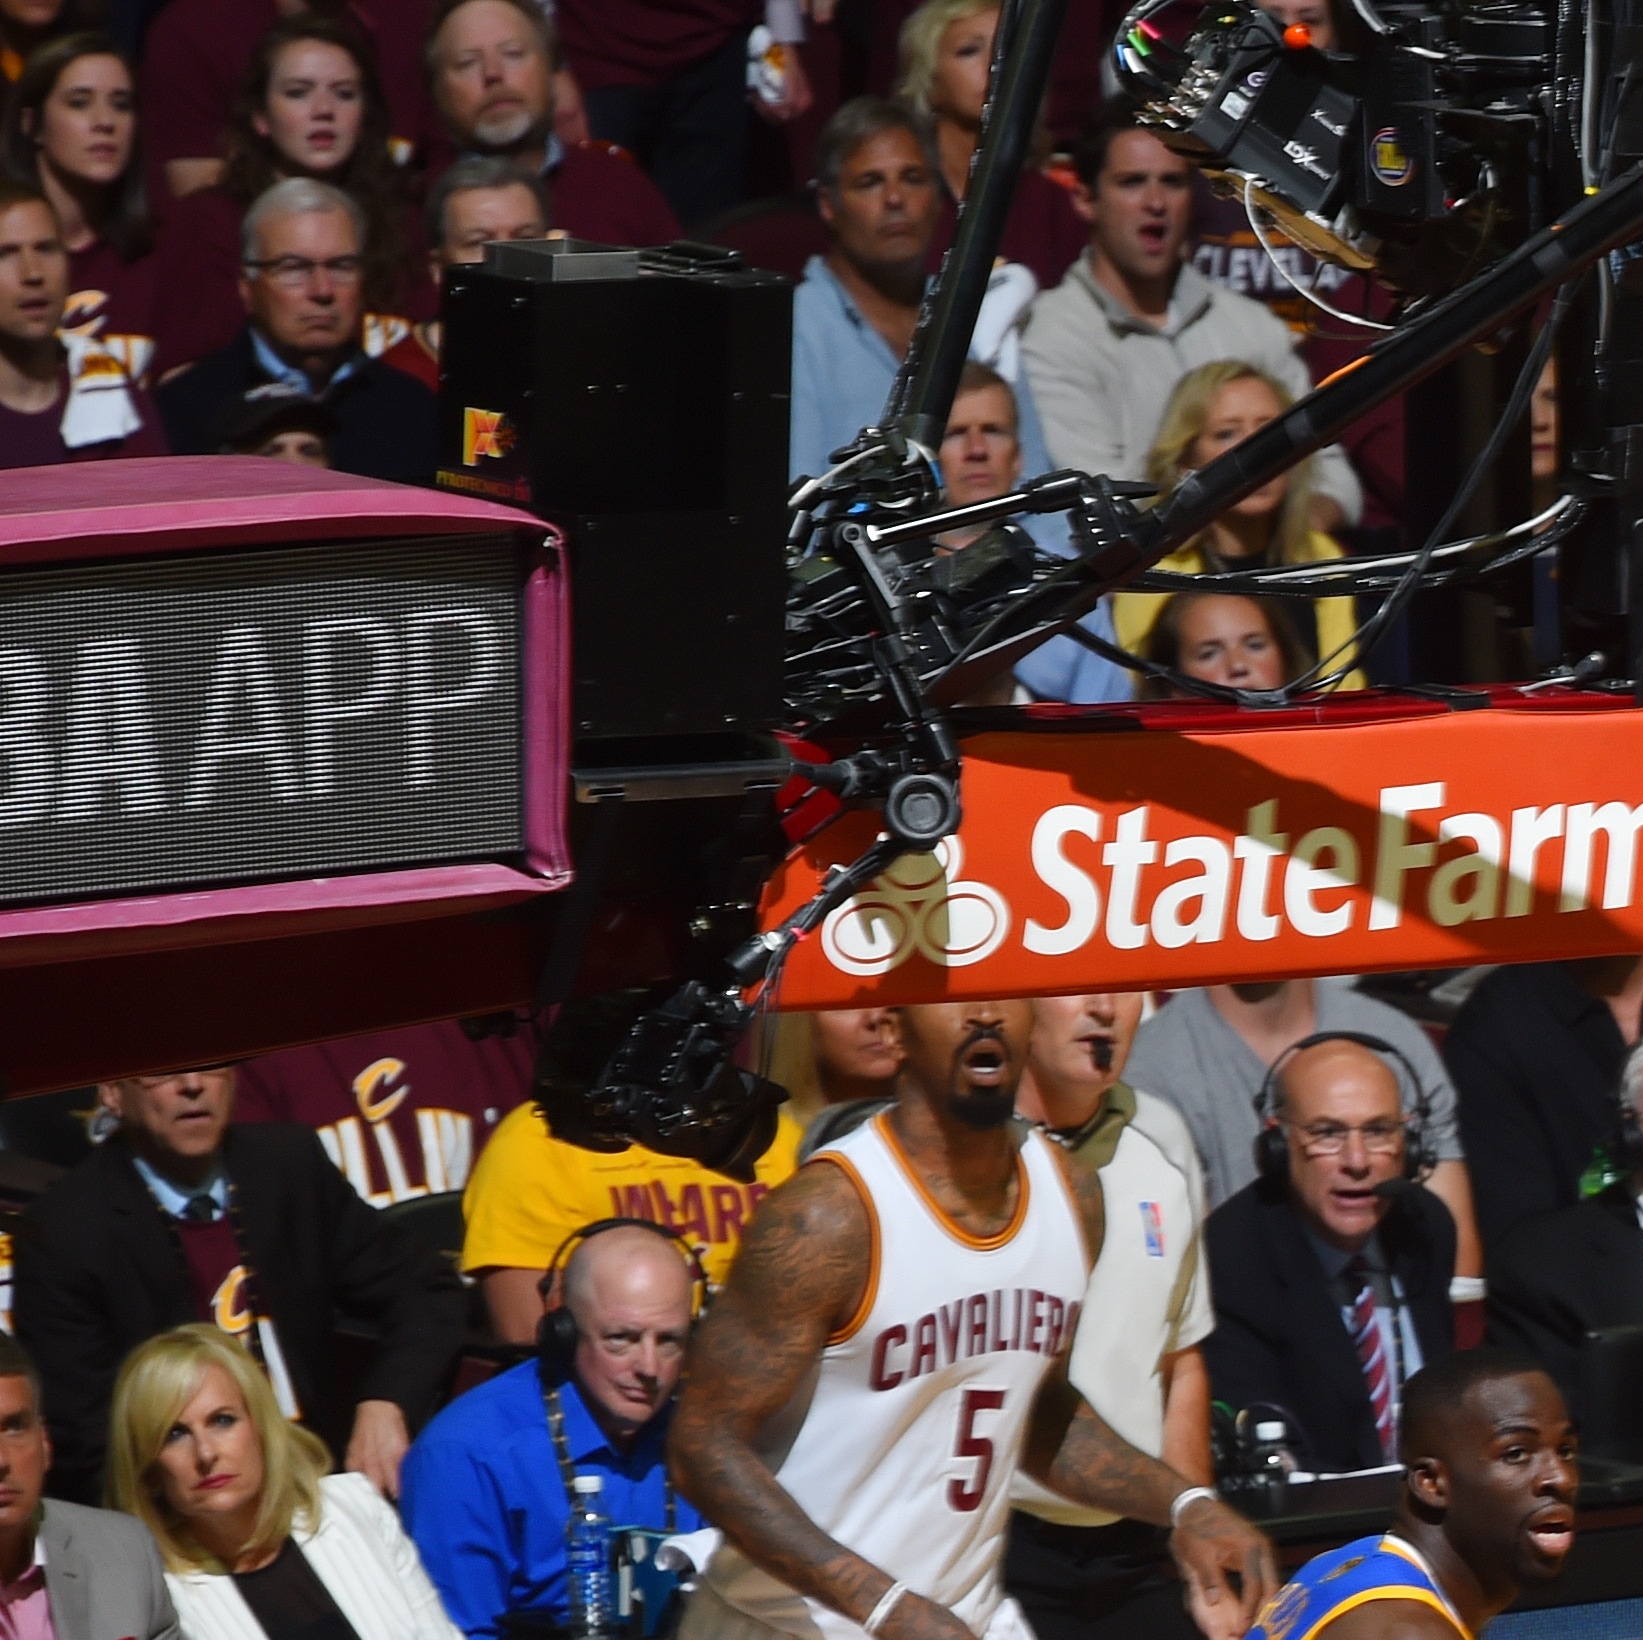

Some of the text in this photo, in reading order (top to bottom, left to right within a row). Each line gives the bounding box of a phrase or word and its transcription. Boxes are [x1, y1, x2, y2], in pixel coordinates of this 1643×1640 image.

[186, 603, 500, 812] APP
[352, 1056, 412, 1123] C
[946, 1388, 1007, 1513] 5
